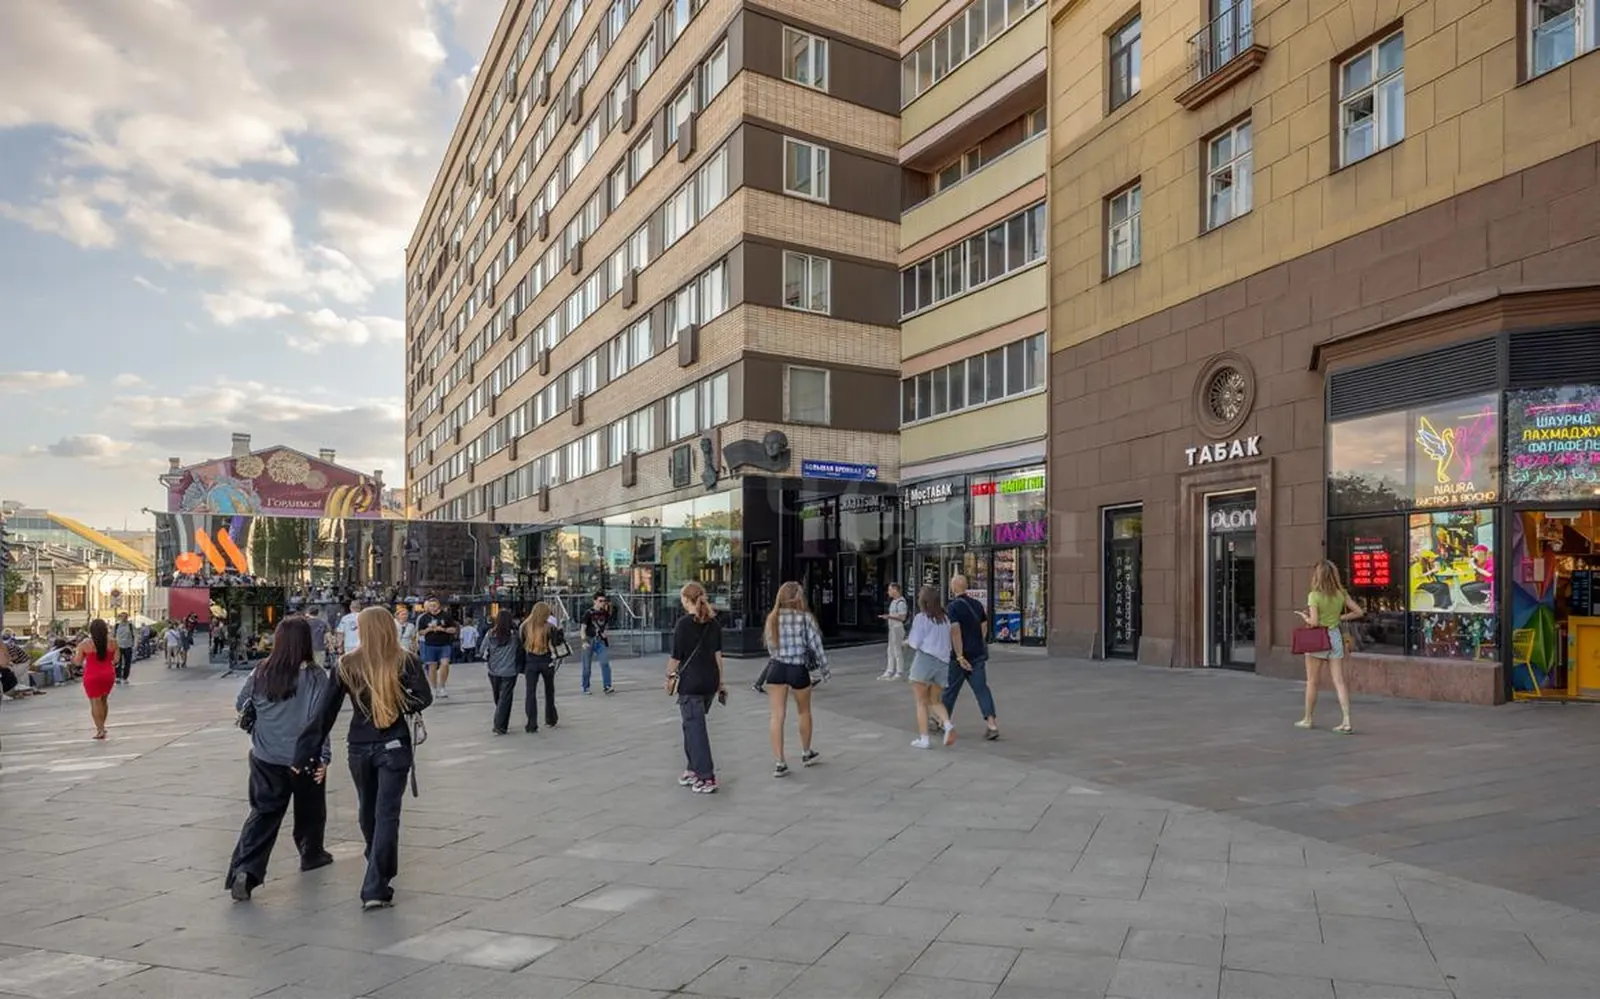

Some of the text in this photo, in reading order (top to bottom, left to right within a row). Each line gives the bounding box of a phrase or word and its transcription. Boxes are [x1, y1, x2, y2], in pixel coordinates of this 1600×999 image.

[1536, 413, 1592, 428] ШАУРМА
[1185, 435, 1262, 466] ТАБАК
[1433, 481, 1475, 495] NAURA
[1415, 495, 1449, 507] БЫСТРО
